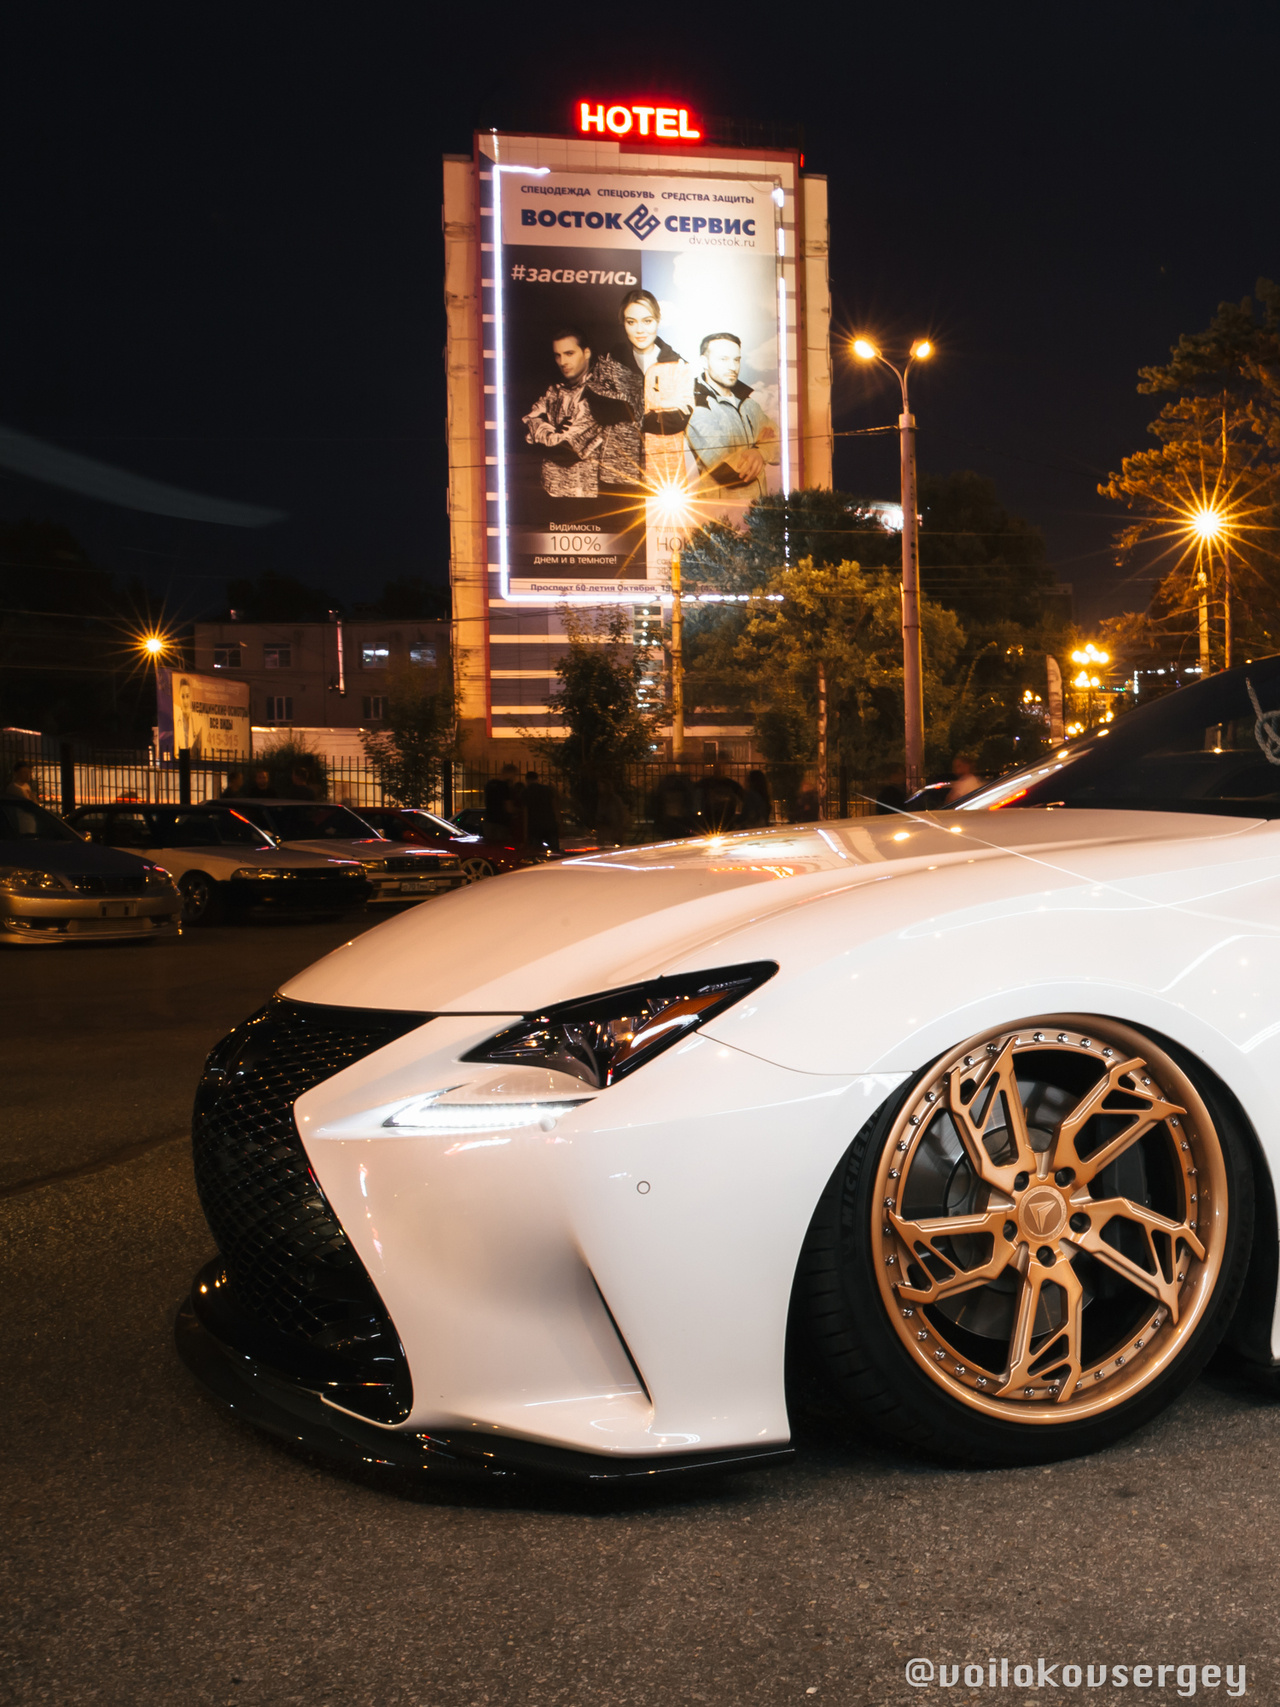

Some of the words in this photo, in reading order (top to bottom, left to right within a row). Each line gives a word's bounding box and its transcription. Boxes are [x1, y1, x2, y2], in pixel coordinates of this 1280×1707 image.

[580, 102, 700, 138] HOTEL
[521, 185, 591, 196] СПЕЦОДЕЖДА
[597, 188, 655, 199] СПЕЦОБУВЬ
[661, 191, 710, 201] СРЕДСТВА
[712, 194, 754, 204] ЗАЩИТЫ
[521, 209, 622, 230] ВОСТОК
[664, 215, 756, 236] СЕРВИС
[688, 235, 755, 247] dv.vostok.ru
[511, 264, 638, 286] #засветись
[549, 522, 601, 532] Видимость
[551, 535, 602, 552] 100%
[533, 556, 559, 565] днем
[578, 556, 617, 565] темноте!
[530, 584, 573, 592] Проспект
[575, 584, 615, 592] 60-летия
[617, 584, 658, 593] Октября,
